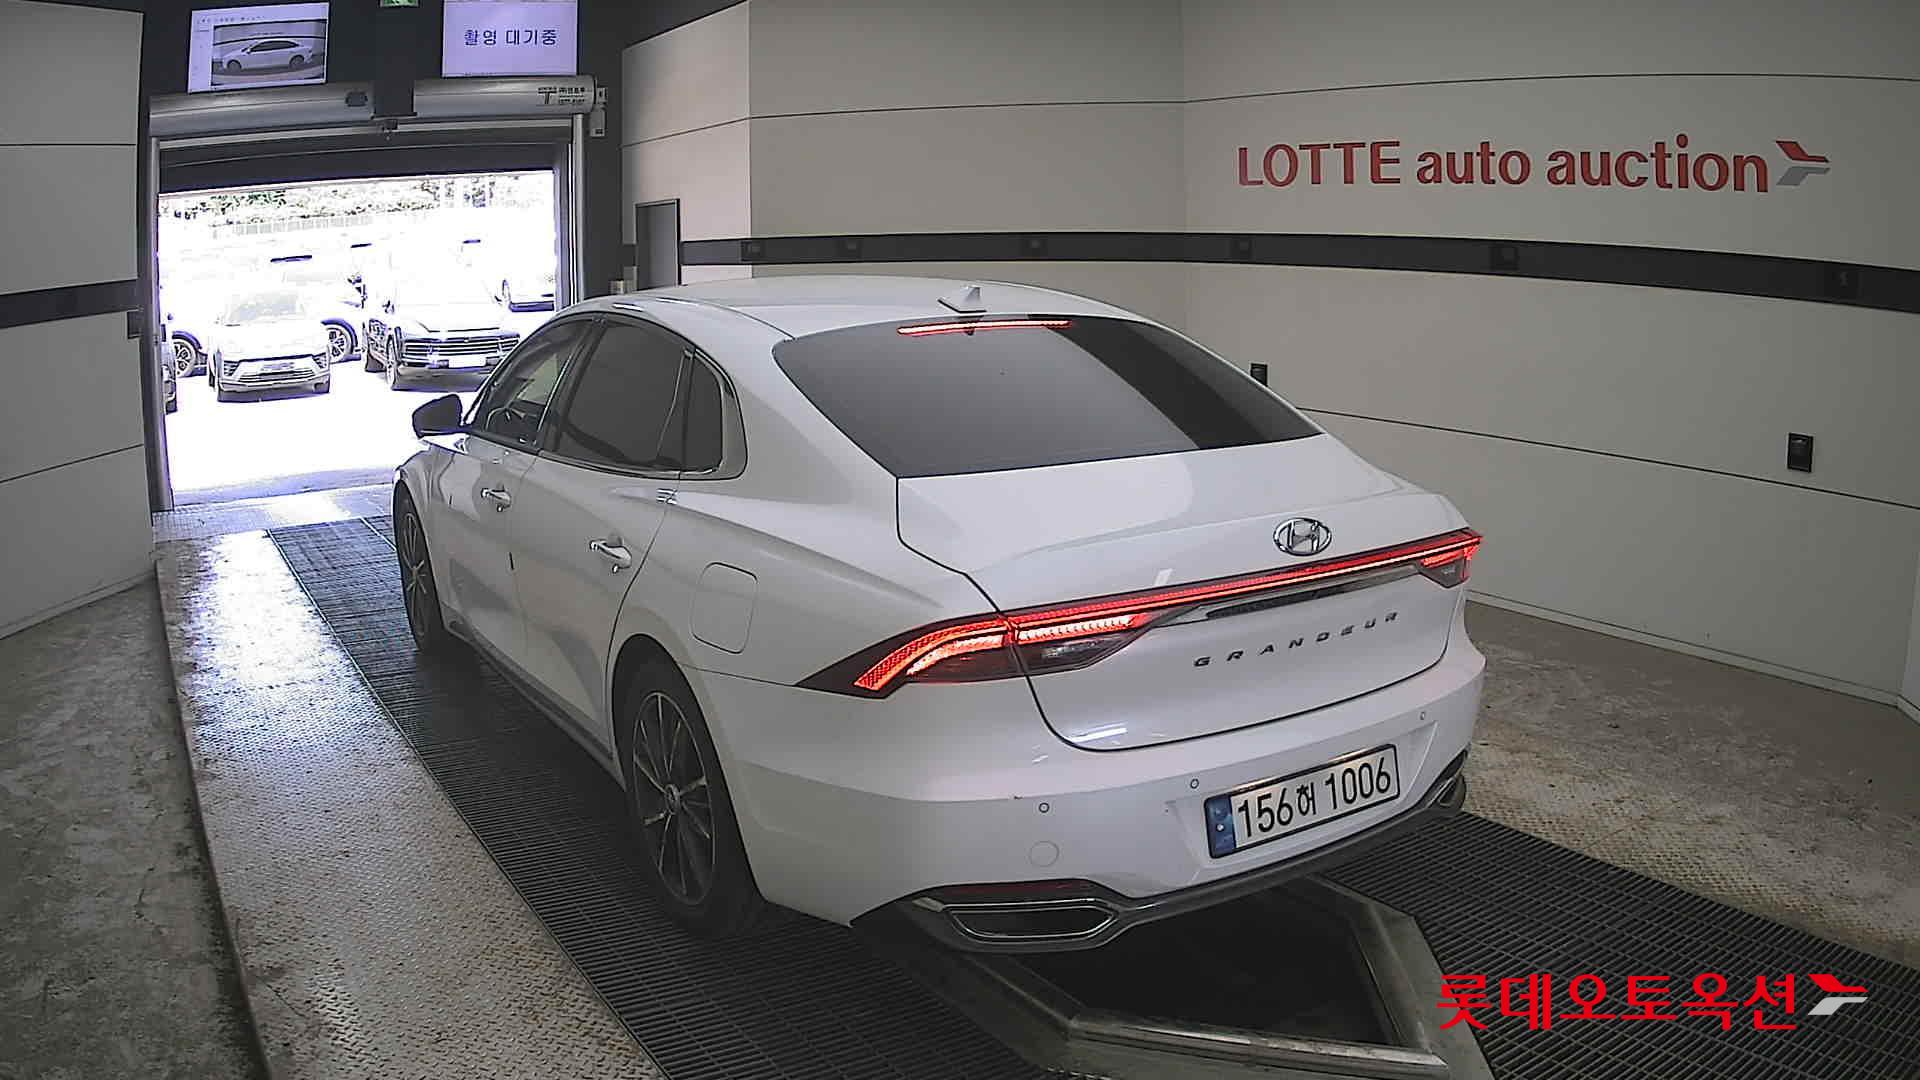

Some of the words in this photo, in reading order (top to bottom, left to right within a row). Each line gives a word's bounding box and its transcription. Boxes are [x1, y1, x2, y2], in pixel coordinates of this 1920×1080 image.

[464, 29, 497, 46] 촬영
[505, 29, 557, 46] 대기중
[1239, 140, 1400, 187] LOTTE
[1416, 141, 1531, 185] auto
[1546, 134, 1769, 193] auction
[1193, 612, 1398, 667] GRANDEUR
[1238, 783, 1316, 837] 156허
[1325, 757, 1391, 810] 1006
